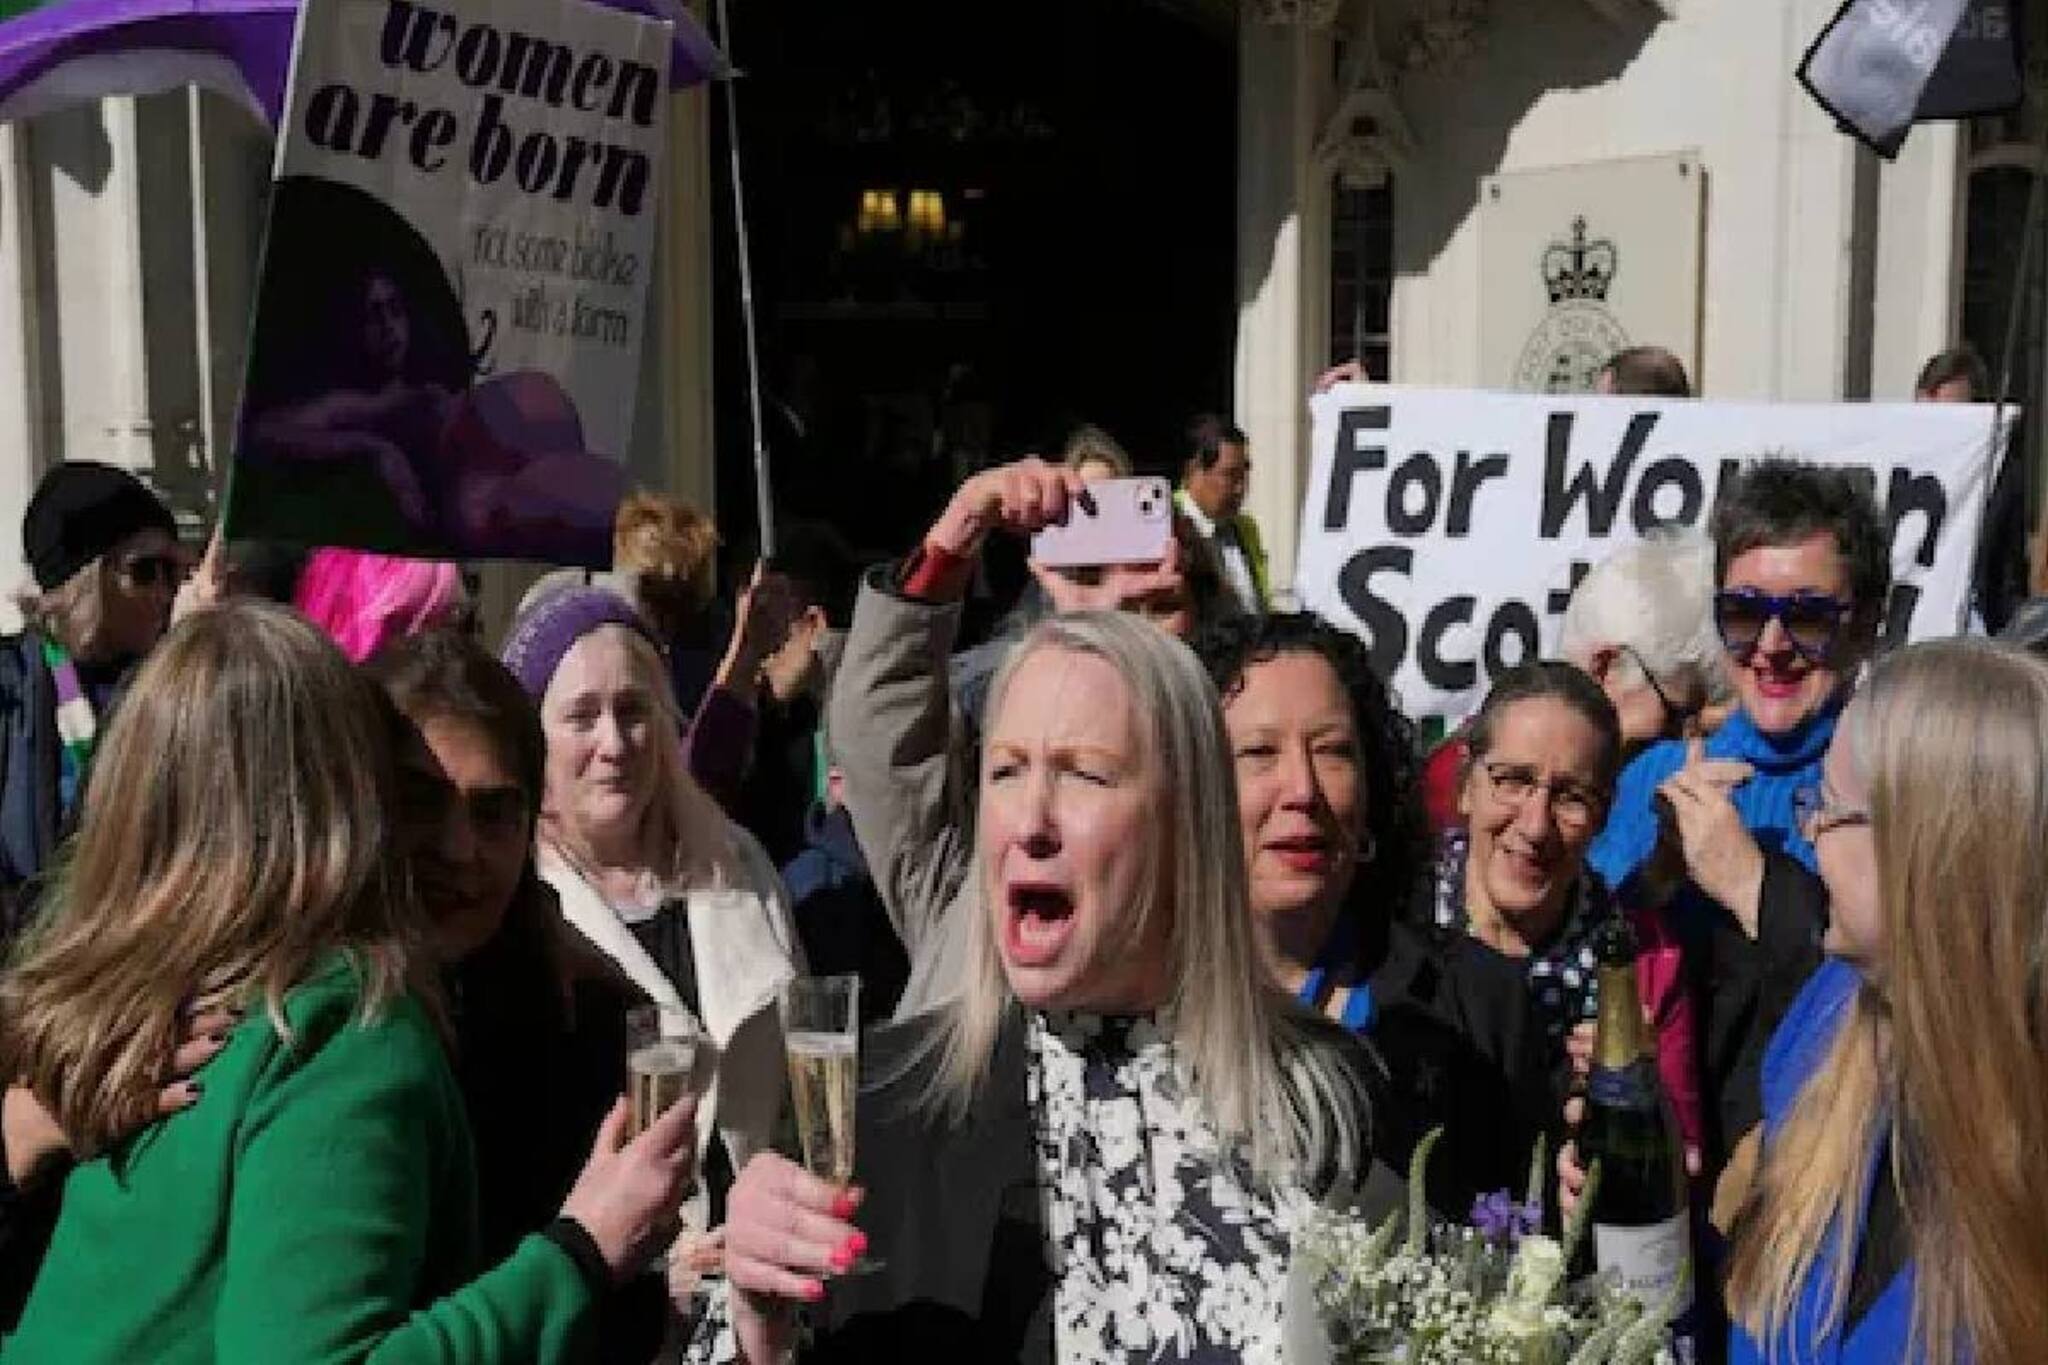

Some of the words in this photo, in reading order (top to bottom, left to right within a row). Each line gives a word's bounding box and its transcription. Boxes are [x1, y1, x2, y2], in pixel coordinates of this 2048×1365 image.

[382, 0, 659, 126] women
[304, 83, 457, 173] are
[470, 94, 647, 215] born
[1324, 405, 1510, 539] For
[1538, 411, 1947, 568] Won
